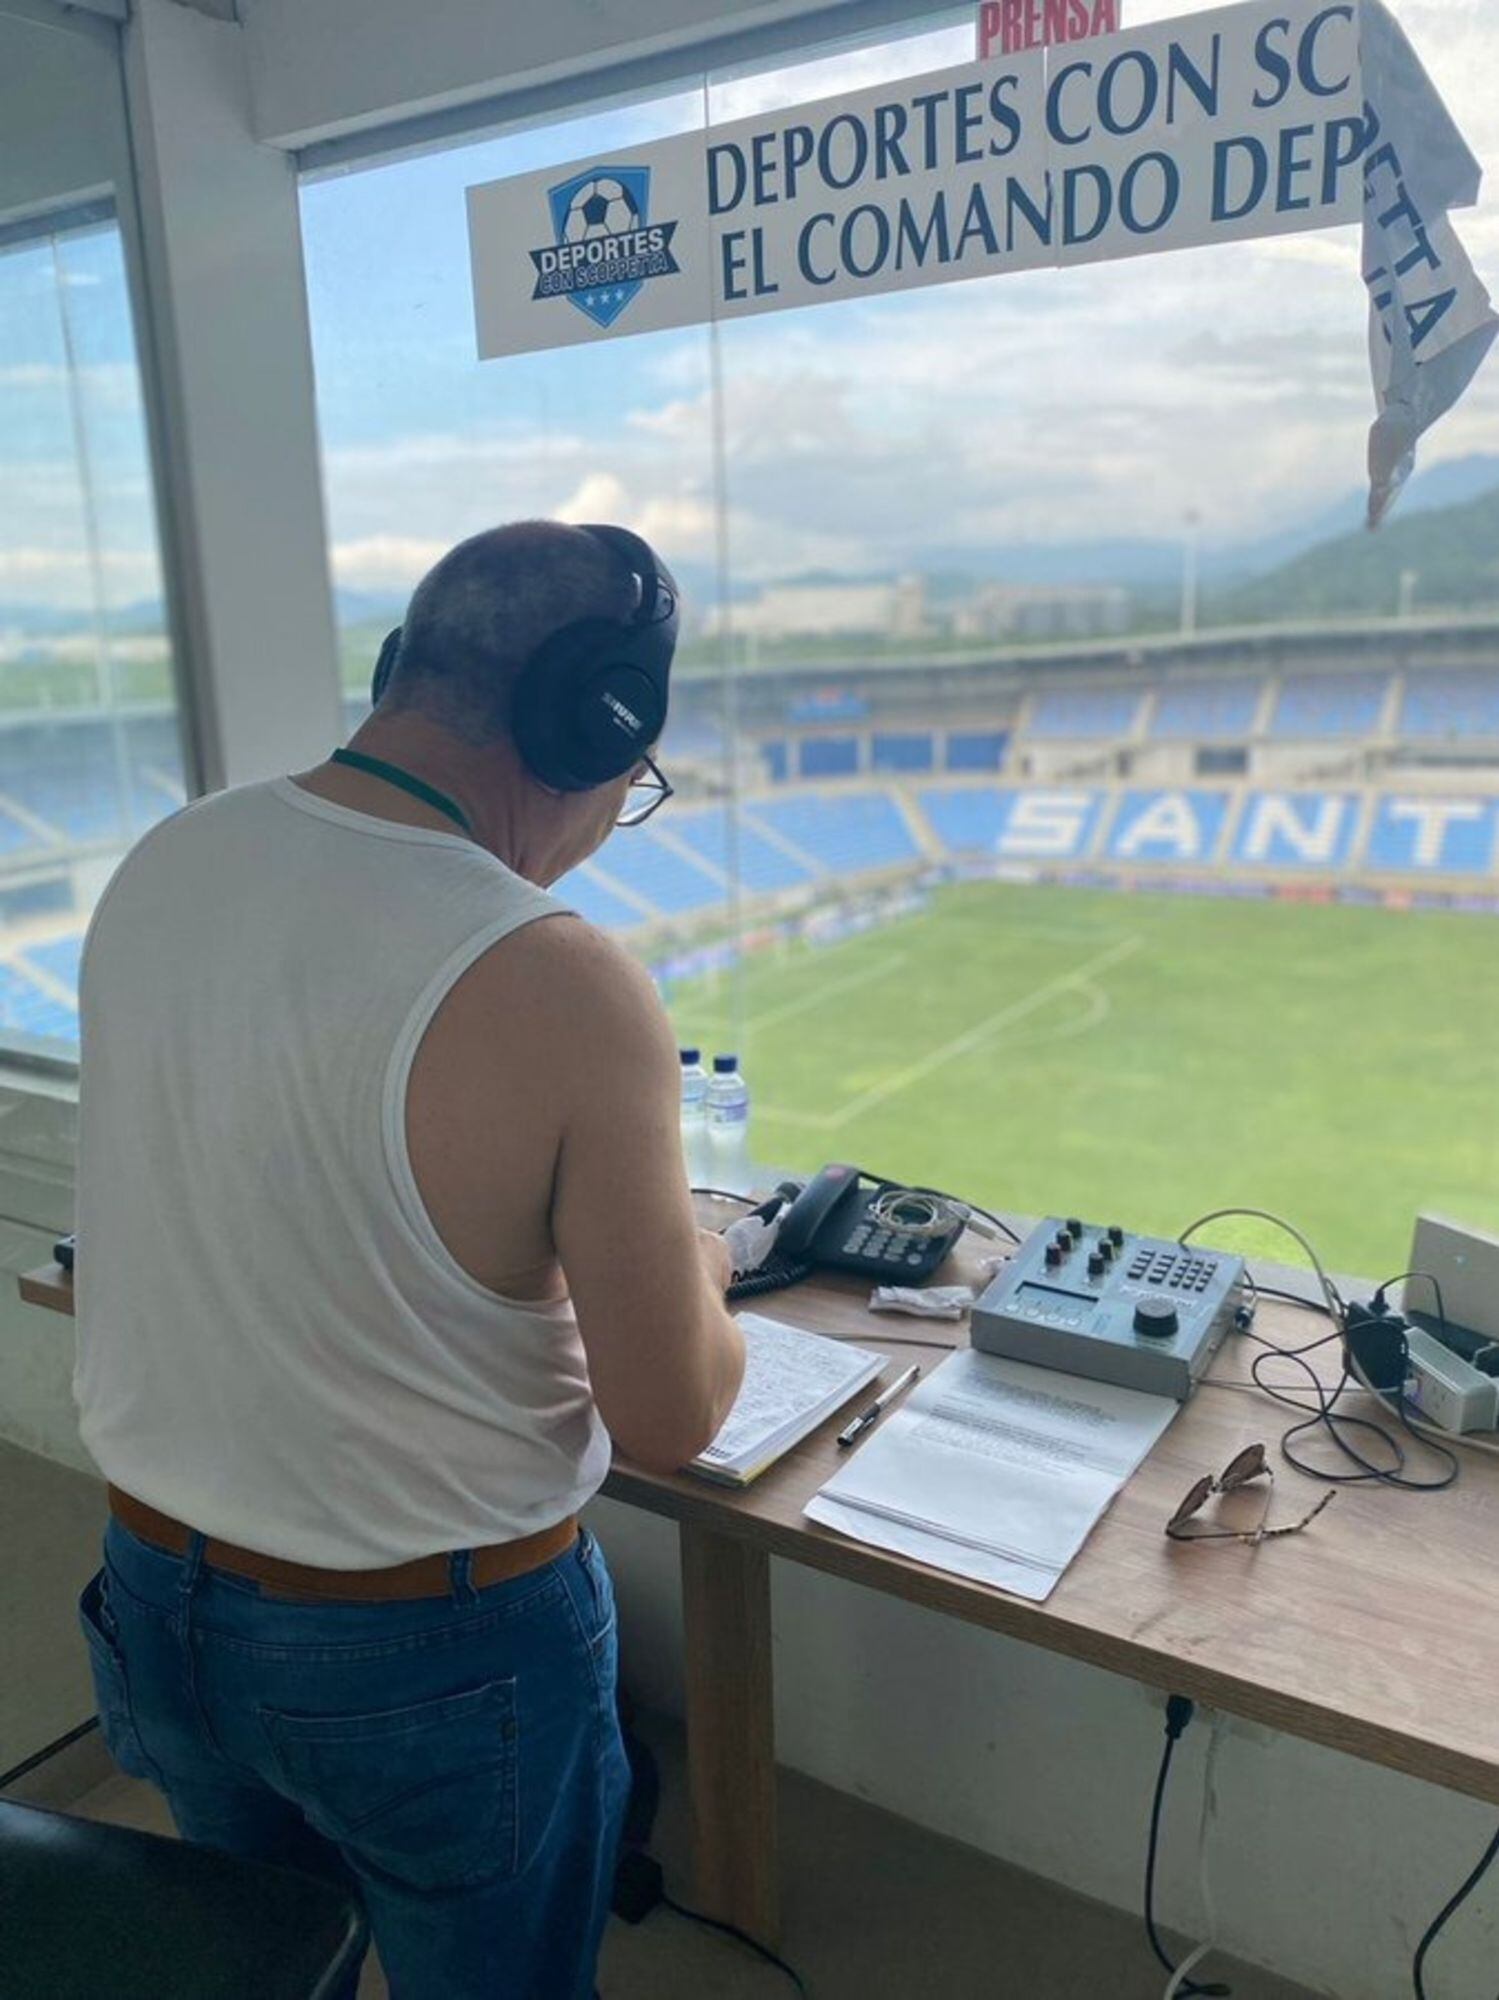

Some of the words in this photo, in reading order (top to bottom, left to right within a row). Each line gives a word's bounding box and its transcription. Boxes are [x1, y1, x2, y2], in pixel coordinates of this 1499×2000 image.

[979, 0, 1117, 60] PRENSA
[707, 74, 1022, 216] DEPORTES
[1045, 33, 1221, 145] CON
[540, 228, 664, 273] DEPORTES
[721, 227, 779, 301] EL
[799, 150, 1181, 285] COMANDO
[539, 268, 574, 295] CON
[997, 793, 1483, 866] SANT
